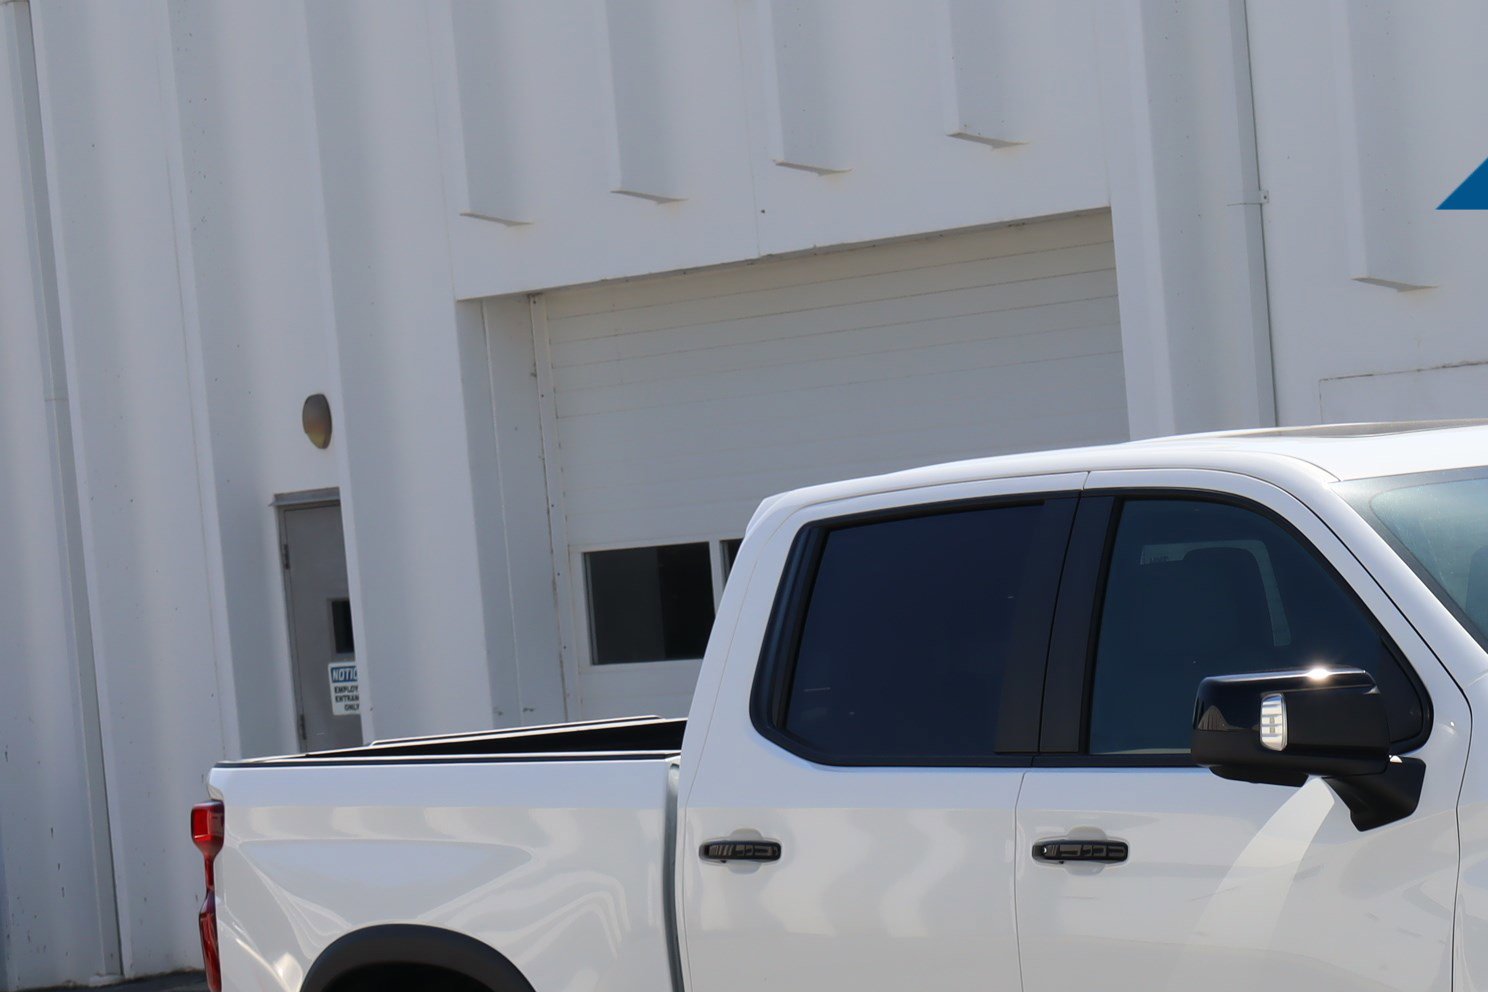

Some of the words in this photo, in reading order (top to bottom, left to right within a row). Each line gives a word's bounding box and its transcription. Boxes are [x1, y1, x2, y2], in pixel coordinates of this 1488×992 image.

[332, 668, 358, 681] NOTIC
[334, 685, 359, 694] EMPLOY
[335, 694, 360, 703] ENTRAN
